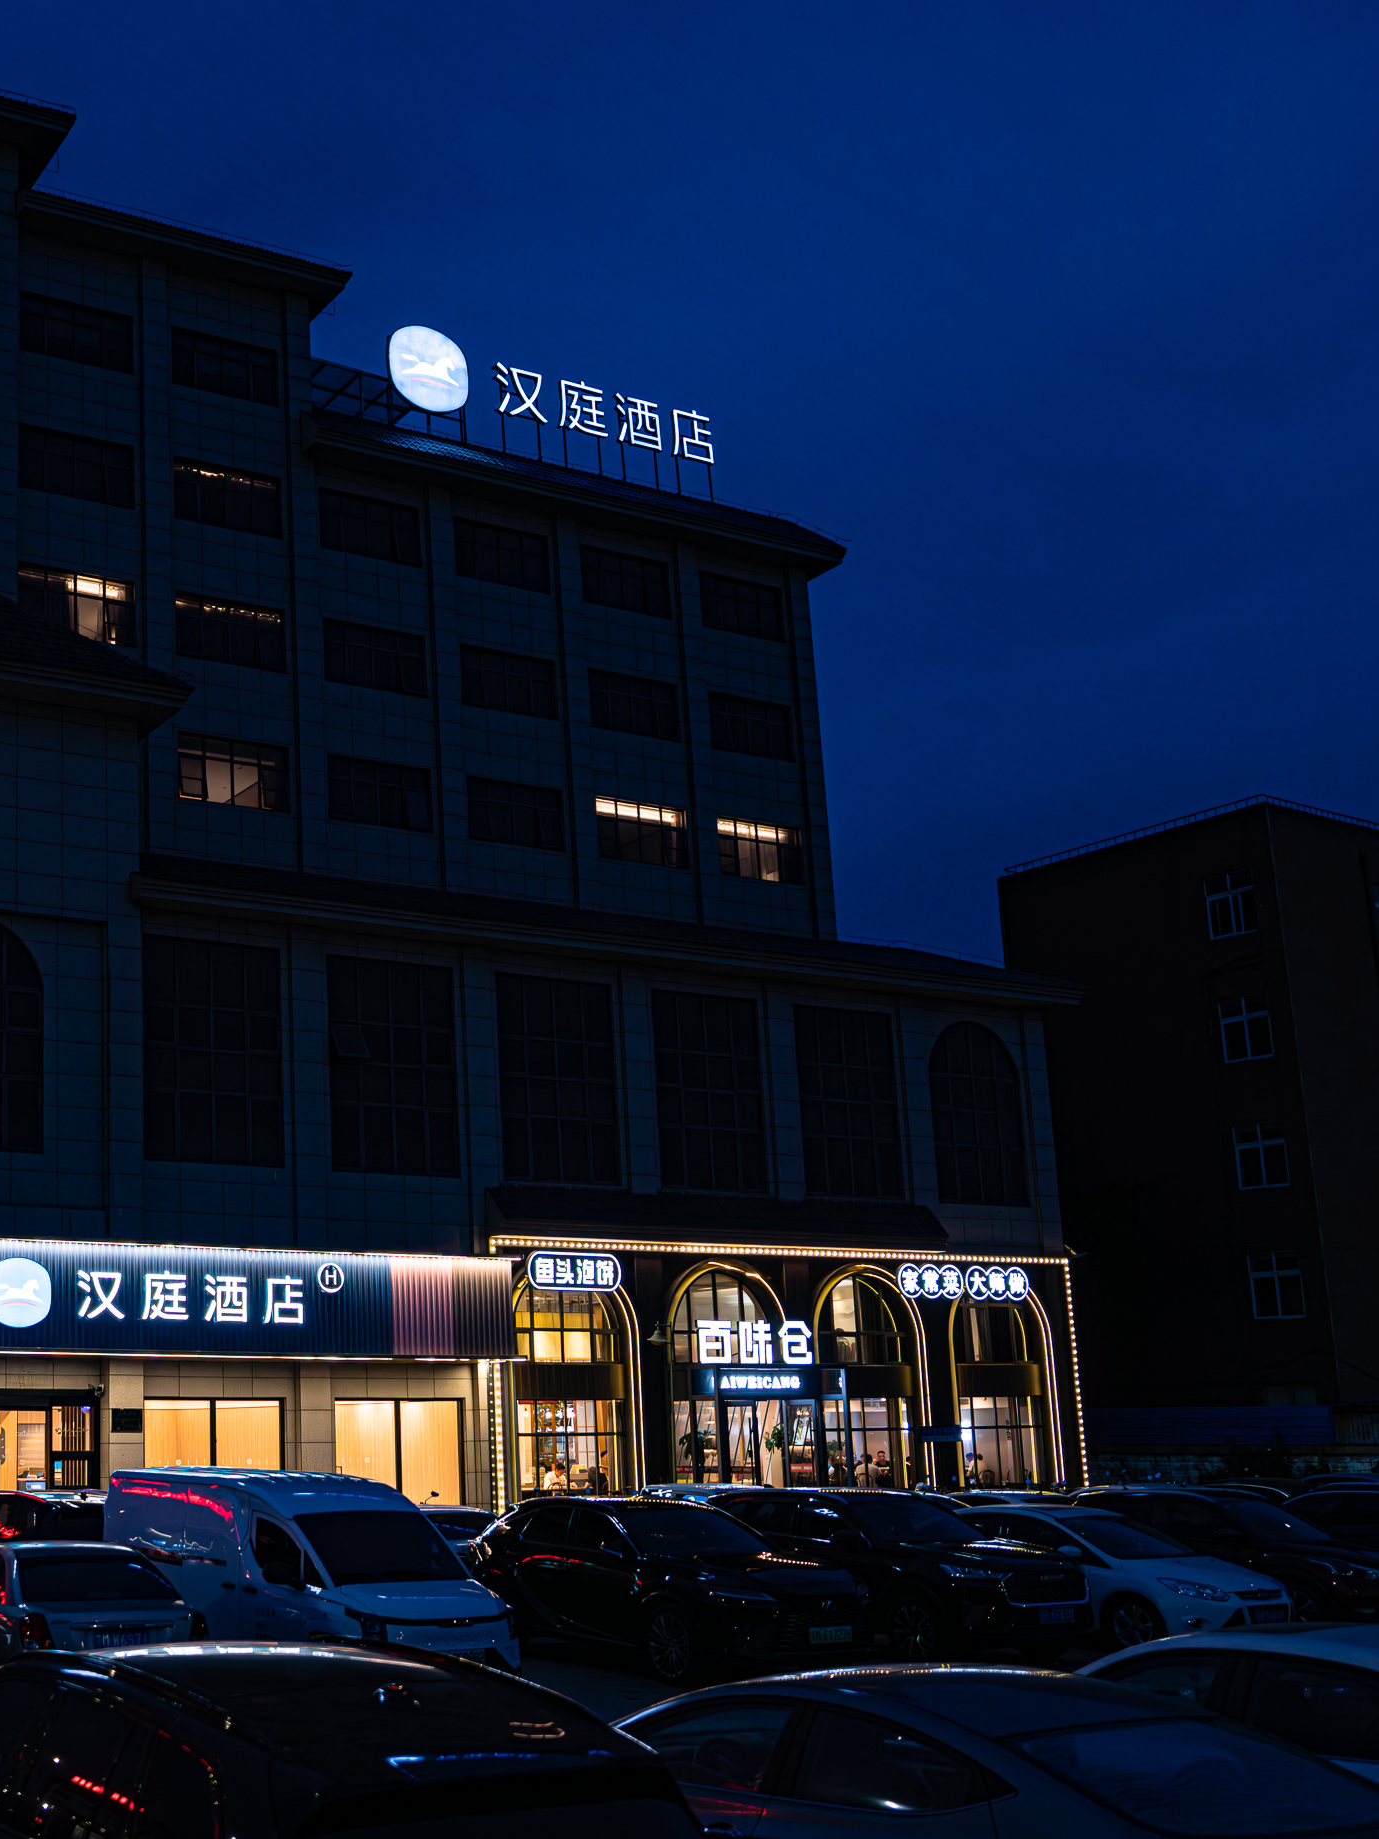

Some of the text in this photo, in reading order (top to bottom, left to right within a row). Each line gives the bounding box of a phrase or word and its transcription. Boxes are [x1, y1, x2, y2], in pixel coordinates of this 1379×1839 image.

[493, 361, 715, 464] 汉庭酒店
[535, 1257, 614, 1286] 鱼头泡饼
[902, 1268, 961, 1294] 家常菜
[76, 1269, 305, 1325] 汉庭酒店
[696, 1319, 813, 1364] 百味仓
[711, 1375, 802, 1389] AIWEICANG
